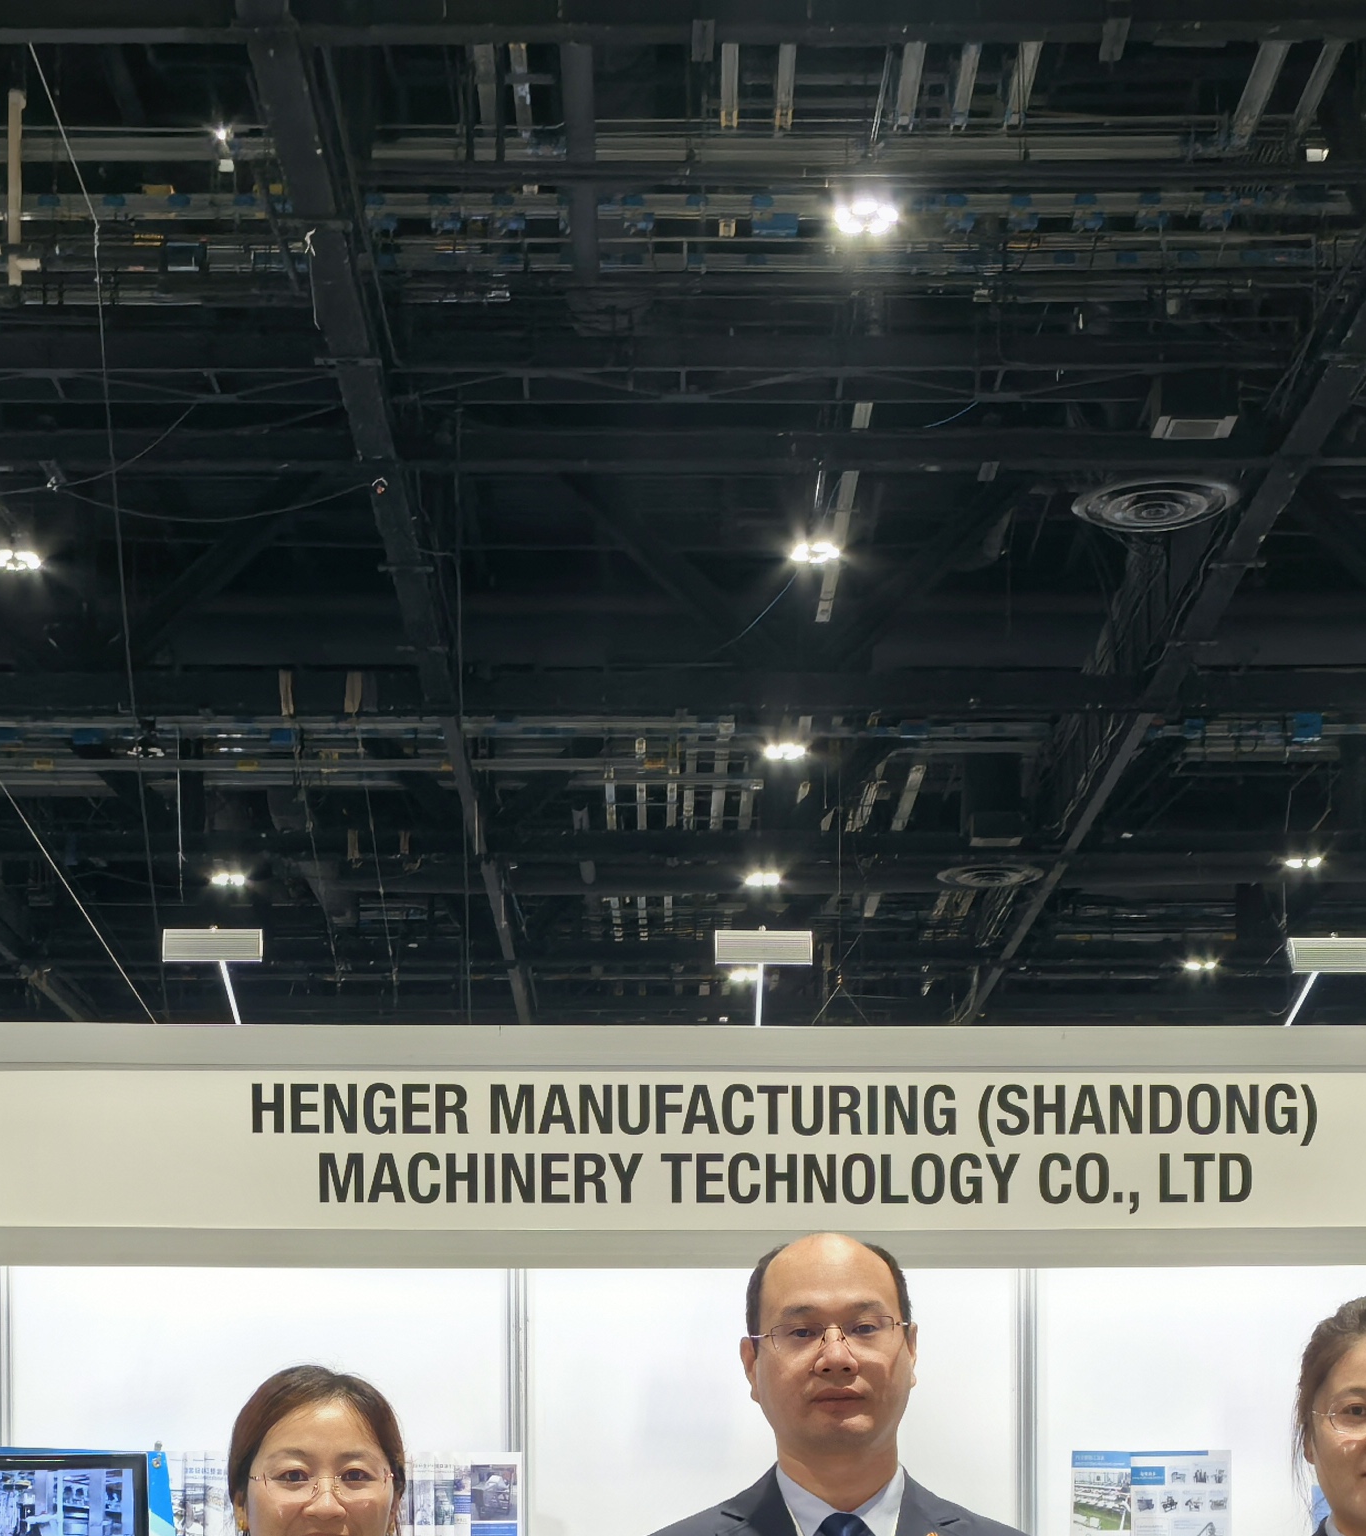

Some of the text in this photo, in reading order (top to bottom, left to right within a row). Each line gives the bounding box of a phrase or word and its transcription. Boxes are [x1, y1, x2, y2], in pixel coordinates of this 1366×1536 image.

[252, 1083, 1318, 1147] HENGER MANUFACTURING (SHANDONG)
[318, 1152, 1253, 1214] MACHINERY TECHNOLOGY CO., LTD
